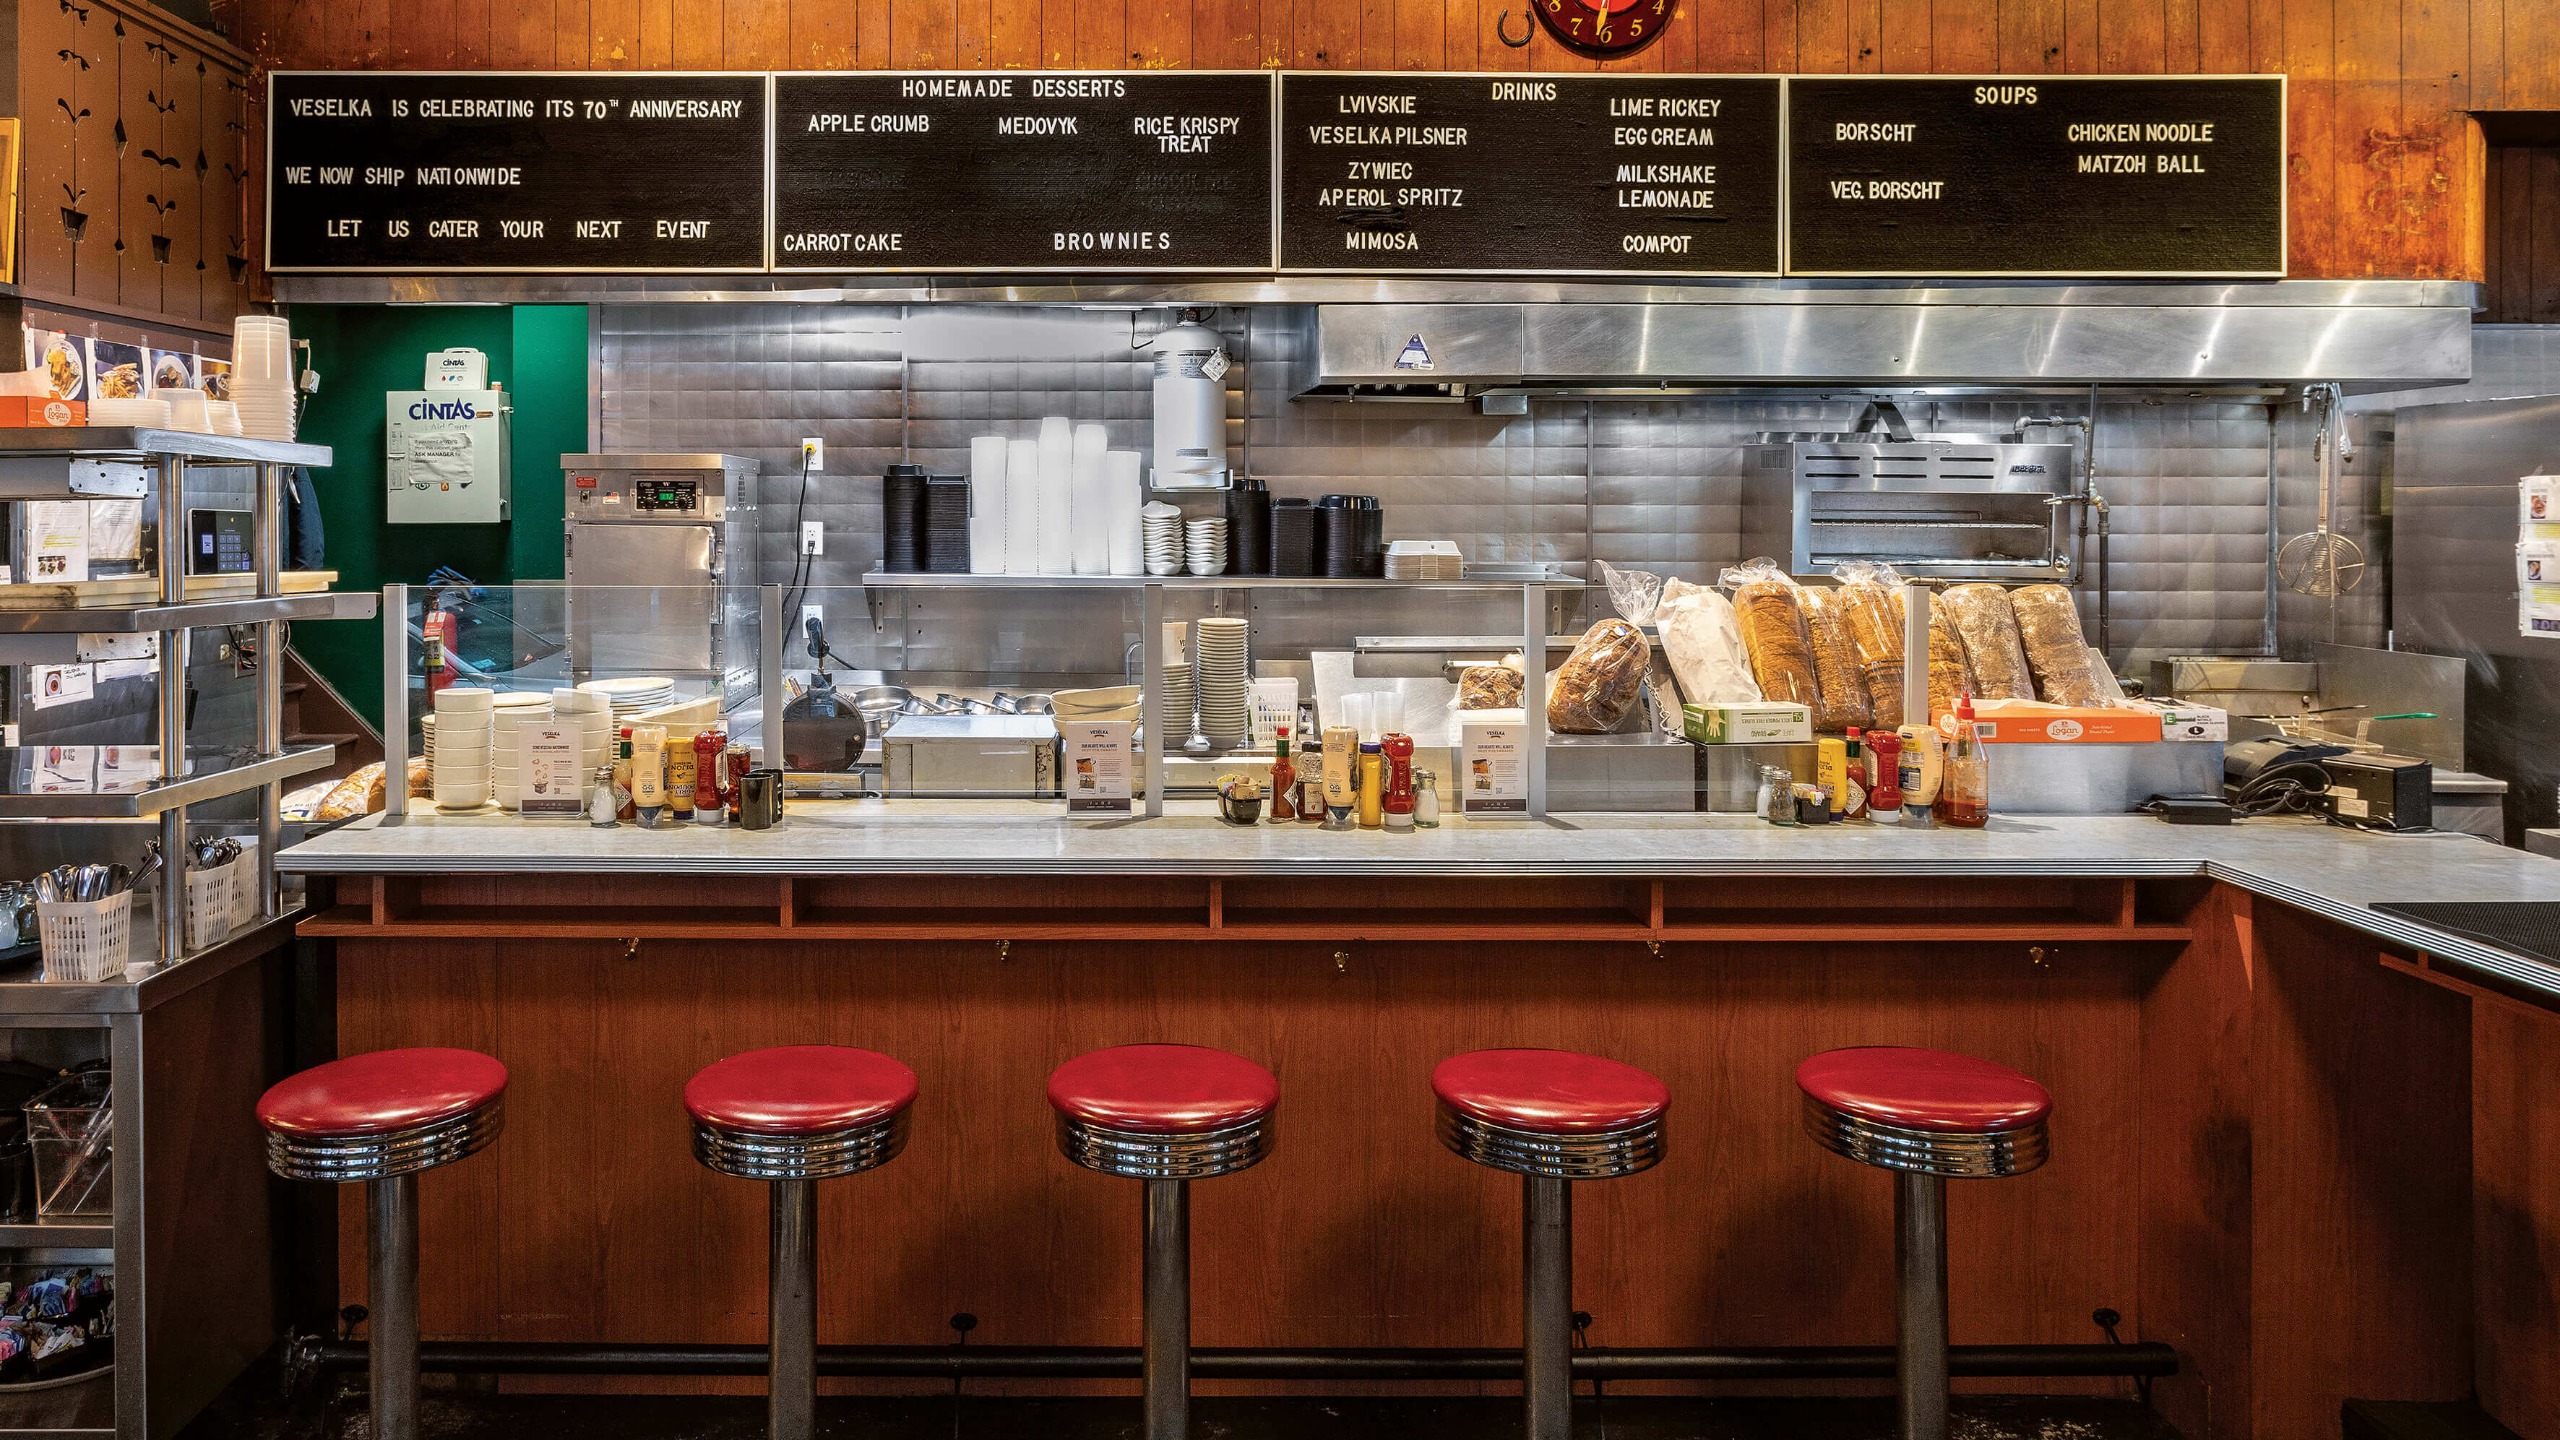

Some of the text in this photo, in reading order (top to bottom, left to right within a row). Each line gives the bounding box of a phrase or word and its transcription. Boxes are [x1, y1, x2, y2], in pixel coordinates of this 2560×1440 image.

[1652, 0, 1665, 15] 4
[1570, 17, 1584, 35] 7
[1600, 25, 1615, 43] 6
[1630, 18, 1643, 36] 5
[902, 79, 1126, 98] HOMEMADE DESSERTS
[1491, 82, 1557, 101] DRINKS
[1974, 86, 2038, 105] SOUPS
[290, 98, 372, 117] VESELKA
[392, 99, 409, 117] IS
[419, 99, 534, 118] CELEBRATING
[546, 99, 575, 118] ITS
[629, 99, 743, 119] ANNIVERSARY
[1339, 95, 1417, 114] LVIVSKIE
[1610, 97, 1722, 118] LIME RICKEY
[807, 114, 930, 133] APPLE CRUMB
[998, 116, 1079, 135] MEDOVYK
[1134, 117, 1240, 135] RICE KRISPY
[1836, 122, 1917, 143] BORSCHT
[2067, 123, 2215, 142] CHICKEN NOODLE
[1158, 136, 1212, 153] TREAT
[1309, 125, 1468, 146] VESELKA PILSNER
[1614, 127, 1714, 146] EGG CREAM
[1347, 161, 1413, 180] ZYWIEC
[2078, 154, 2206, 174] MATZOH BALL
[285, 166, 522, 187] WE NOW SHIP NATIONWIDE
[1616, 164, 1717, 184] MILKSHAKE
[1318, 187, 1463, 207] APEROL SPRITZ
[1618, 189, 1715, 209] LEMONADE
[1830, 180, 1945, 200] VEG. BORSCHT
[328, 219, 711, 239] LET US CATER YOUR NEXT EVENT
[784, 234, 902, 251] CARROT CAKE
[1054, 231, 1171, 251] BROWNIES
[1346, 230, 1419, 251] MIMOSA
[1622, 234, 1693, 254] COMPOT
[47, 407, 69, 420] Logan
[2051, 725, 2079, 735] Logan
